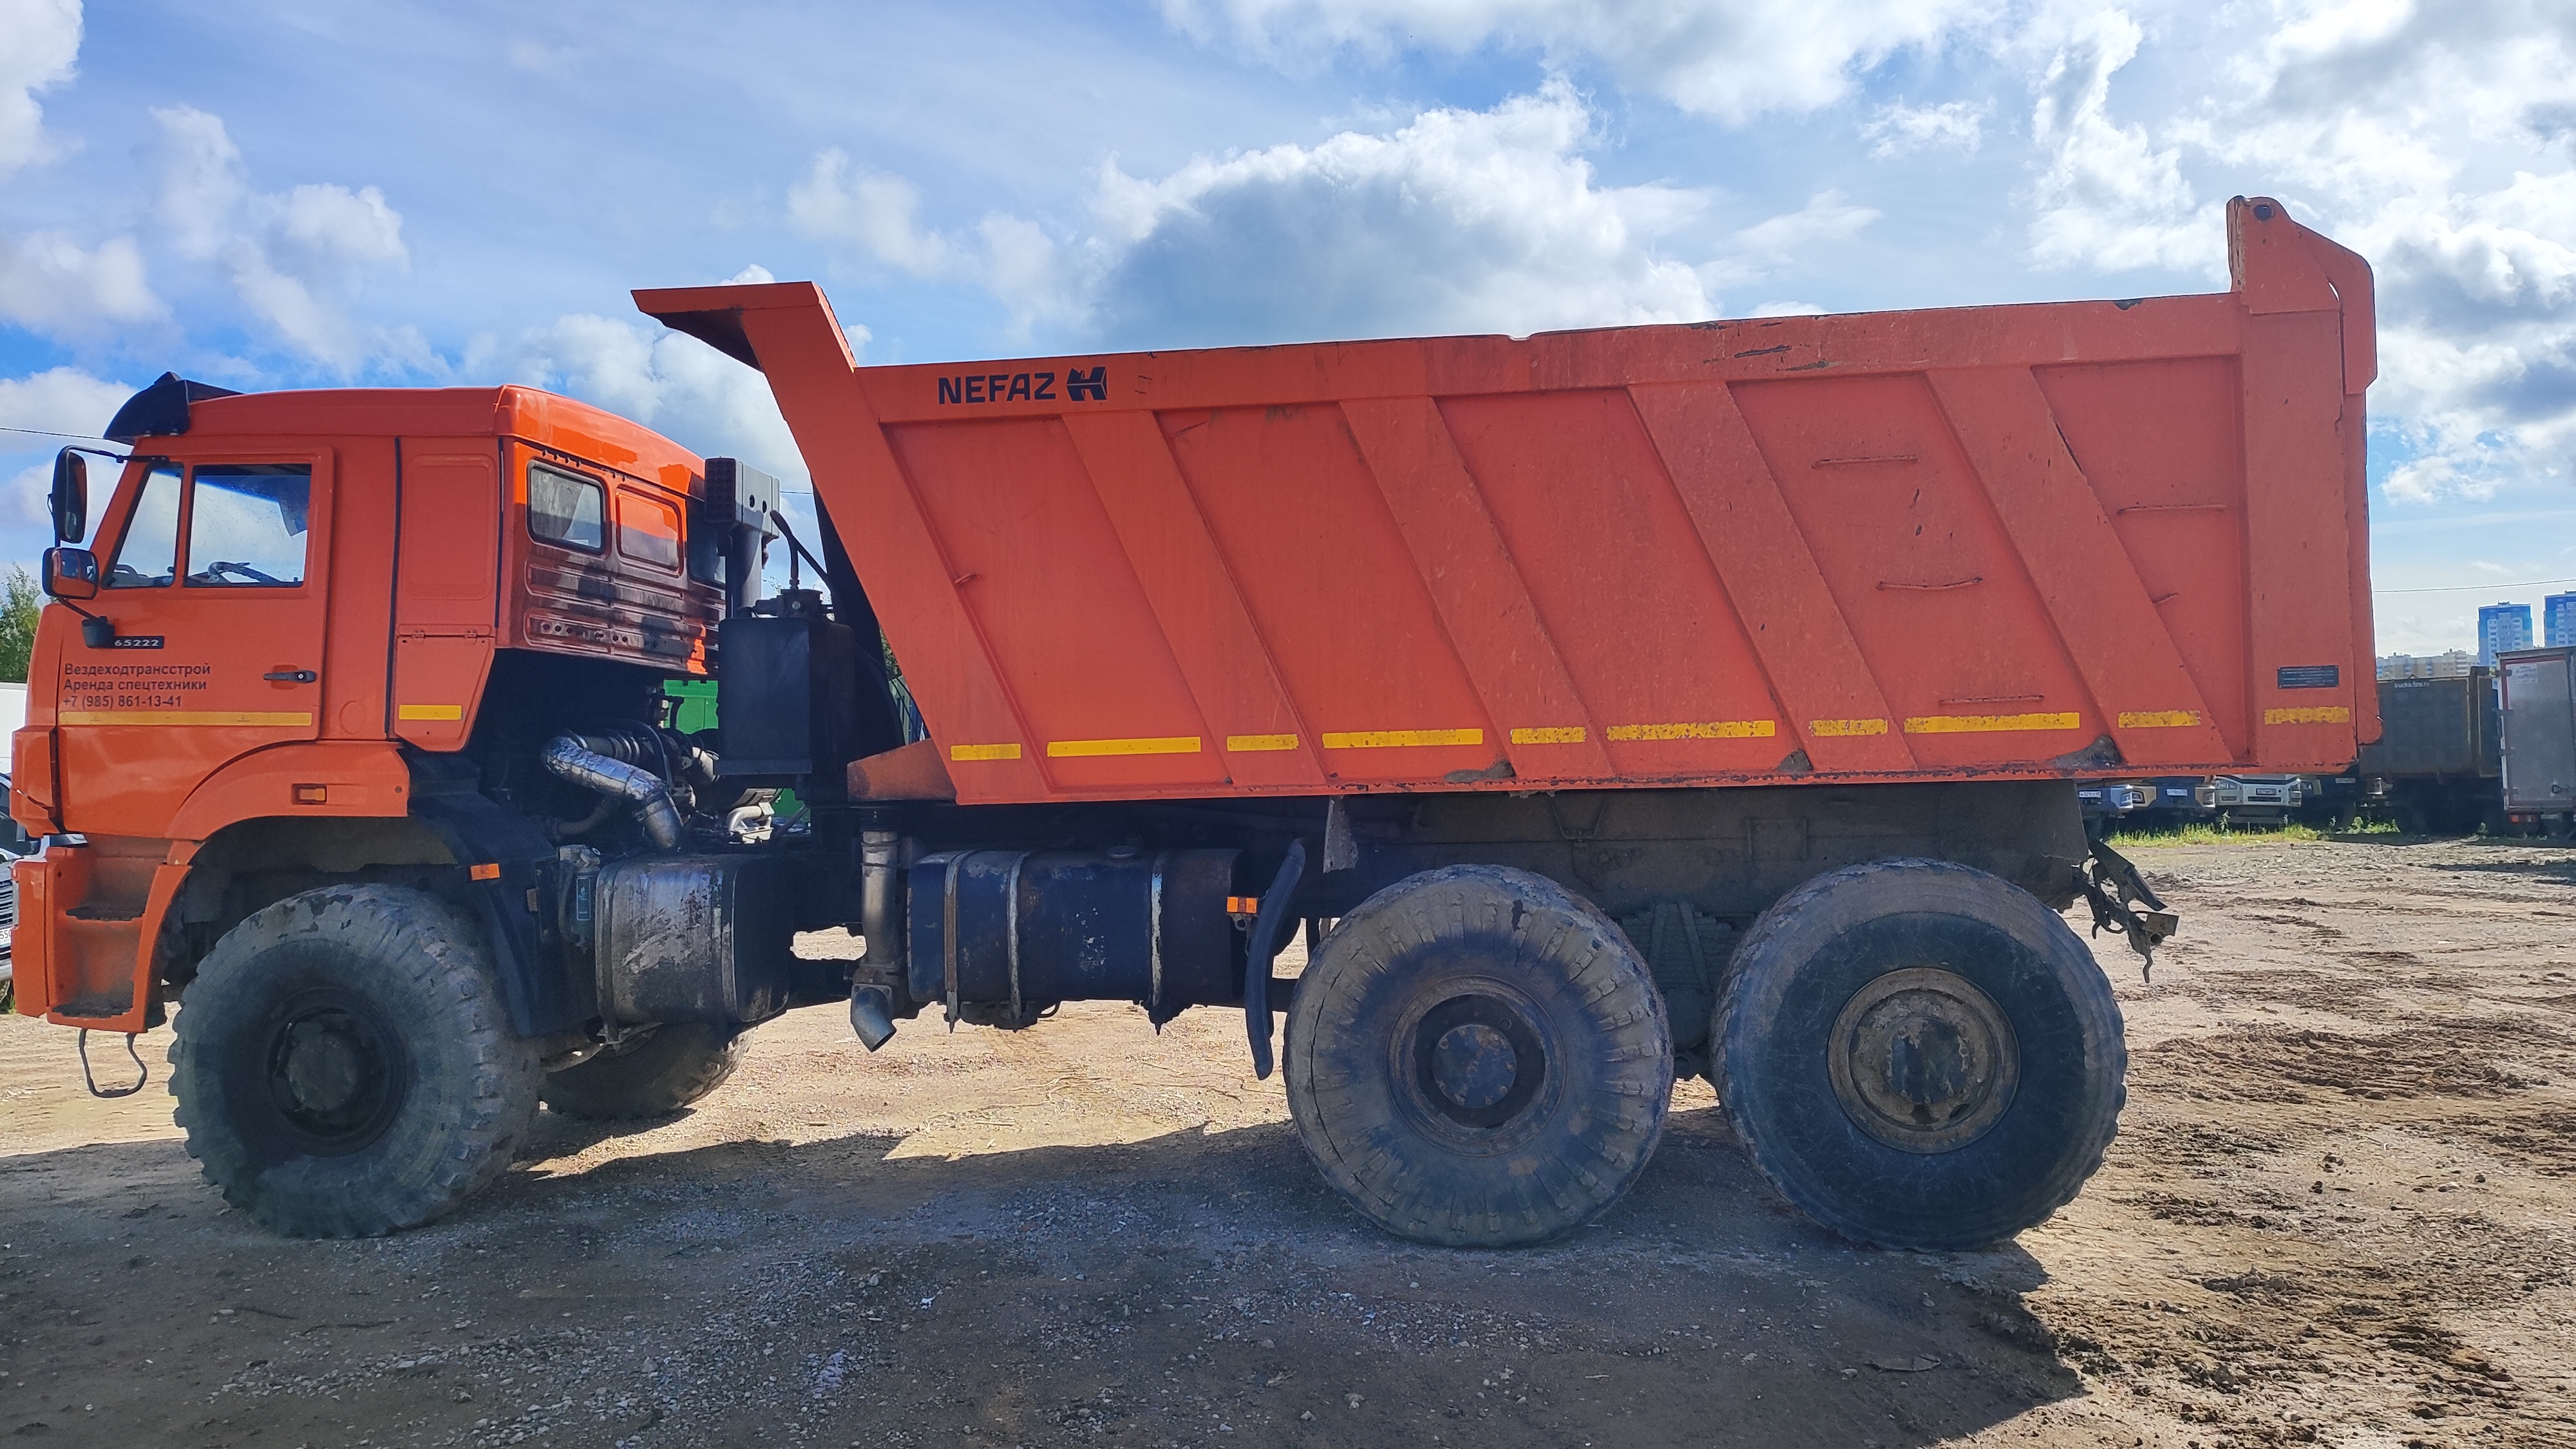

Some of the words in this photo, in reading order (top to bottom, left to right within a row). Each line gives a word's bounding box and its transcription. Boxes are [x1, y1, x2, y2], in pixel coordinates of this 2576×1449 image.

[938, 372, 1056, 404] NEFAZ
[64, 663, 211, 677] Вездеходтрансстрой
[62, 679, 113, 693] Аренда
[118, 680, 207, 692] спецтехники
[63, 696, 78, 707] +7
[82, 696, 113, 709] (985)
[118, 696, 182, 707] 861-13-41
